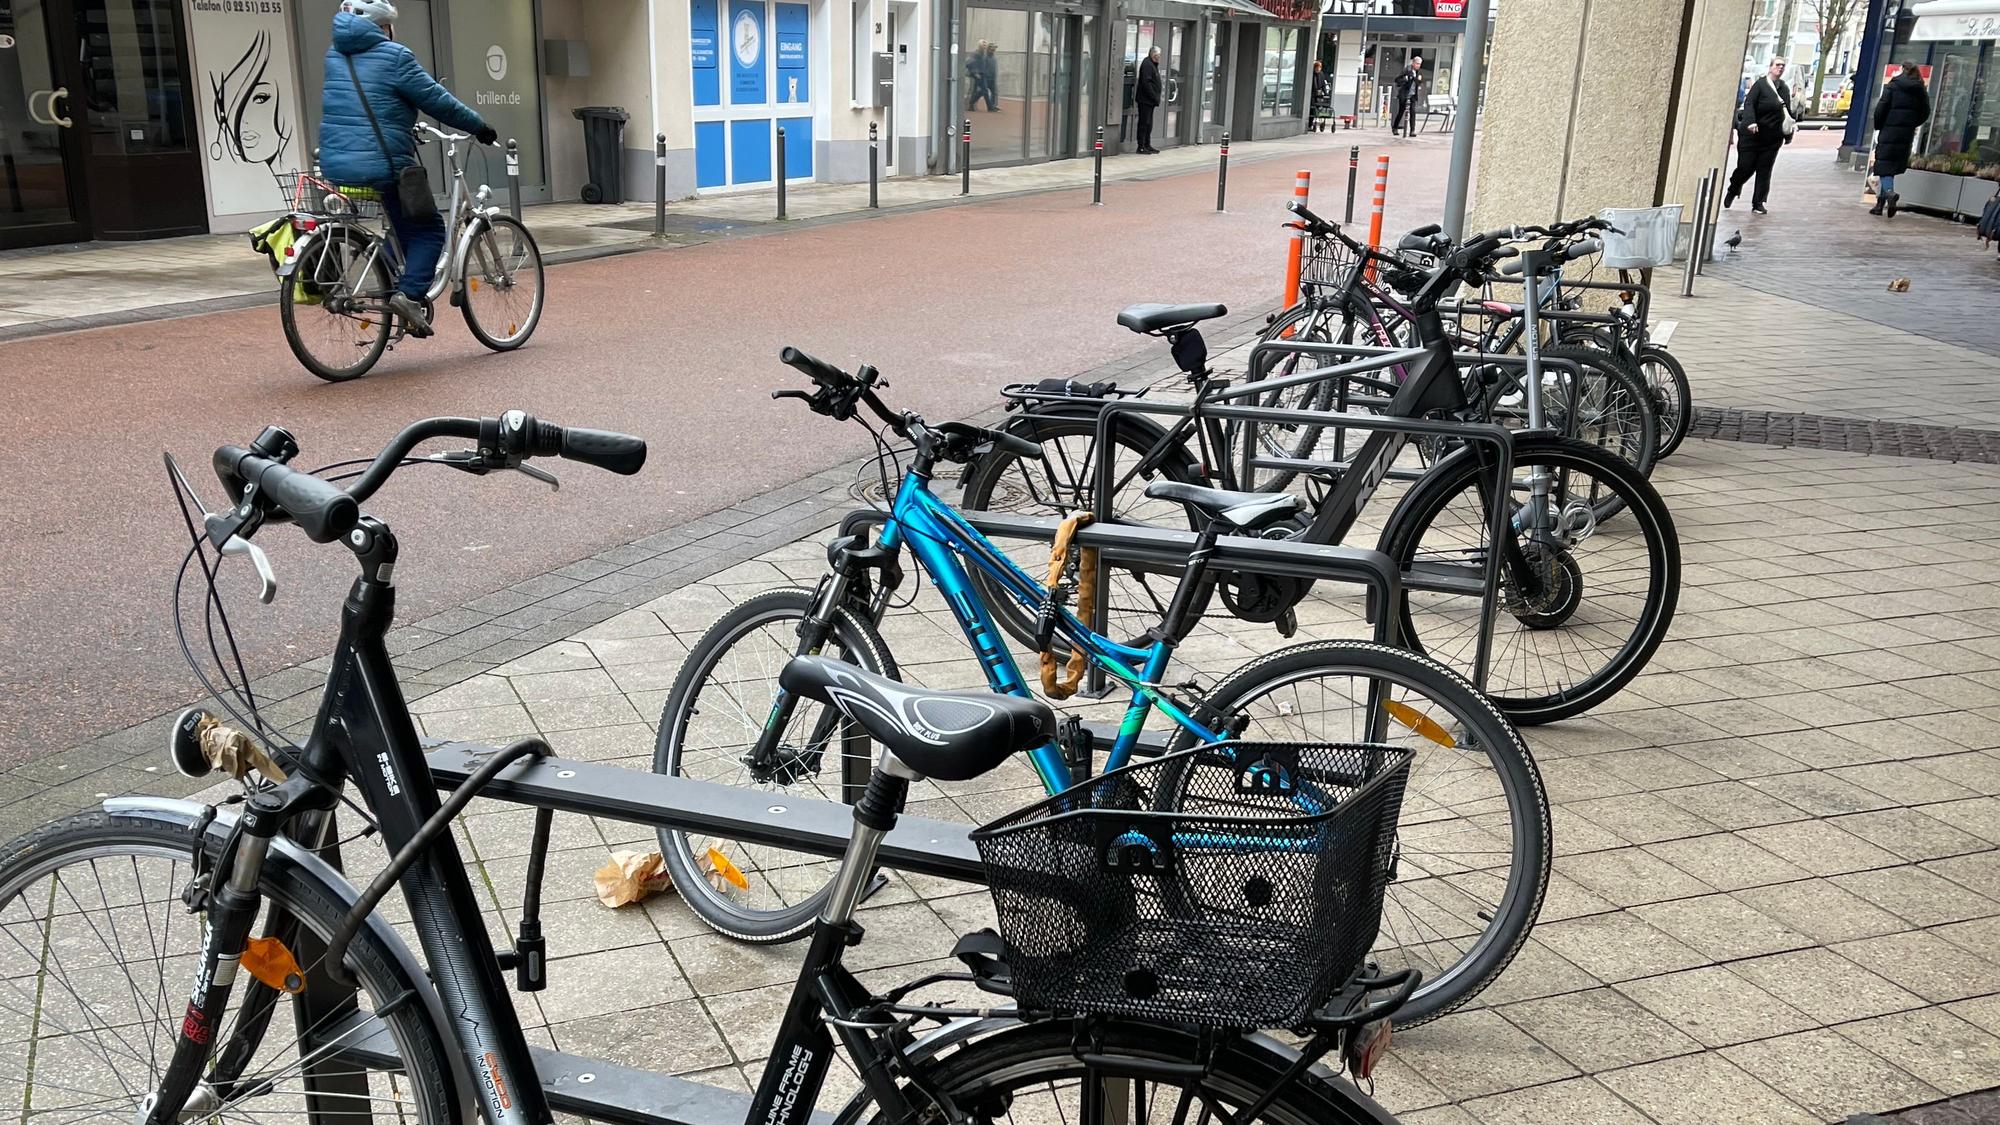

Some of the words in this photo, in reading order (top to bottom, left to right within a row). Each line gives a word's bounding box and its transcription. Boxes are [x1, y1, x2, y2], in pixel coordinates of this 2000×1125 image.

[192, 0, 221, 11] Telefon
[223, 1, 232, 13] (0
[233, 1, 245, 12] 22
[246, 2, 258, 14] 51)
[260, 2, 270, 13] 23
[272, 2, 282, 13] 55
[1437, 4, 1462, 12] KING
[476, 90, 520, 104] brillen.de
[1531, 323, 1540, 361] MOTUS
[923, 731, 941, 741] PLUS
[778, 1044, 803, 1094] FRAME
[476, 1055, 486, 1068] IN
[481, 1070, 505, 1119] MOTION
[775, 1048, 814, 1125] HNOLOGY
